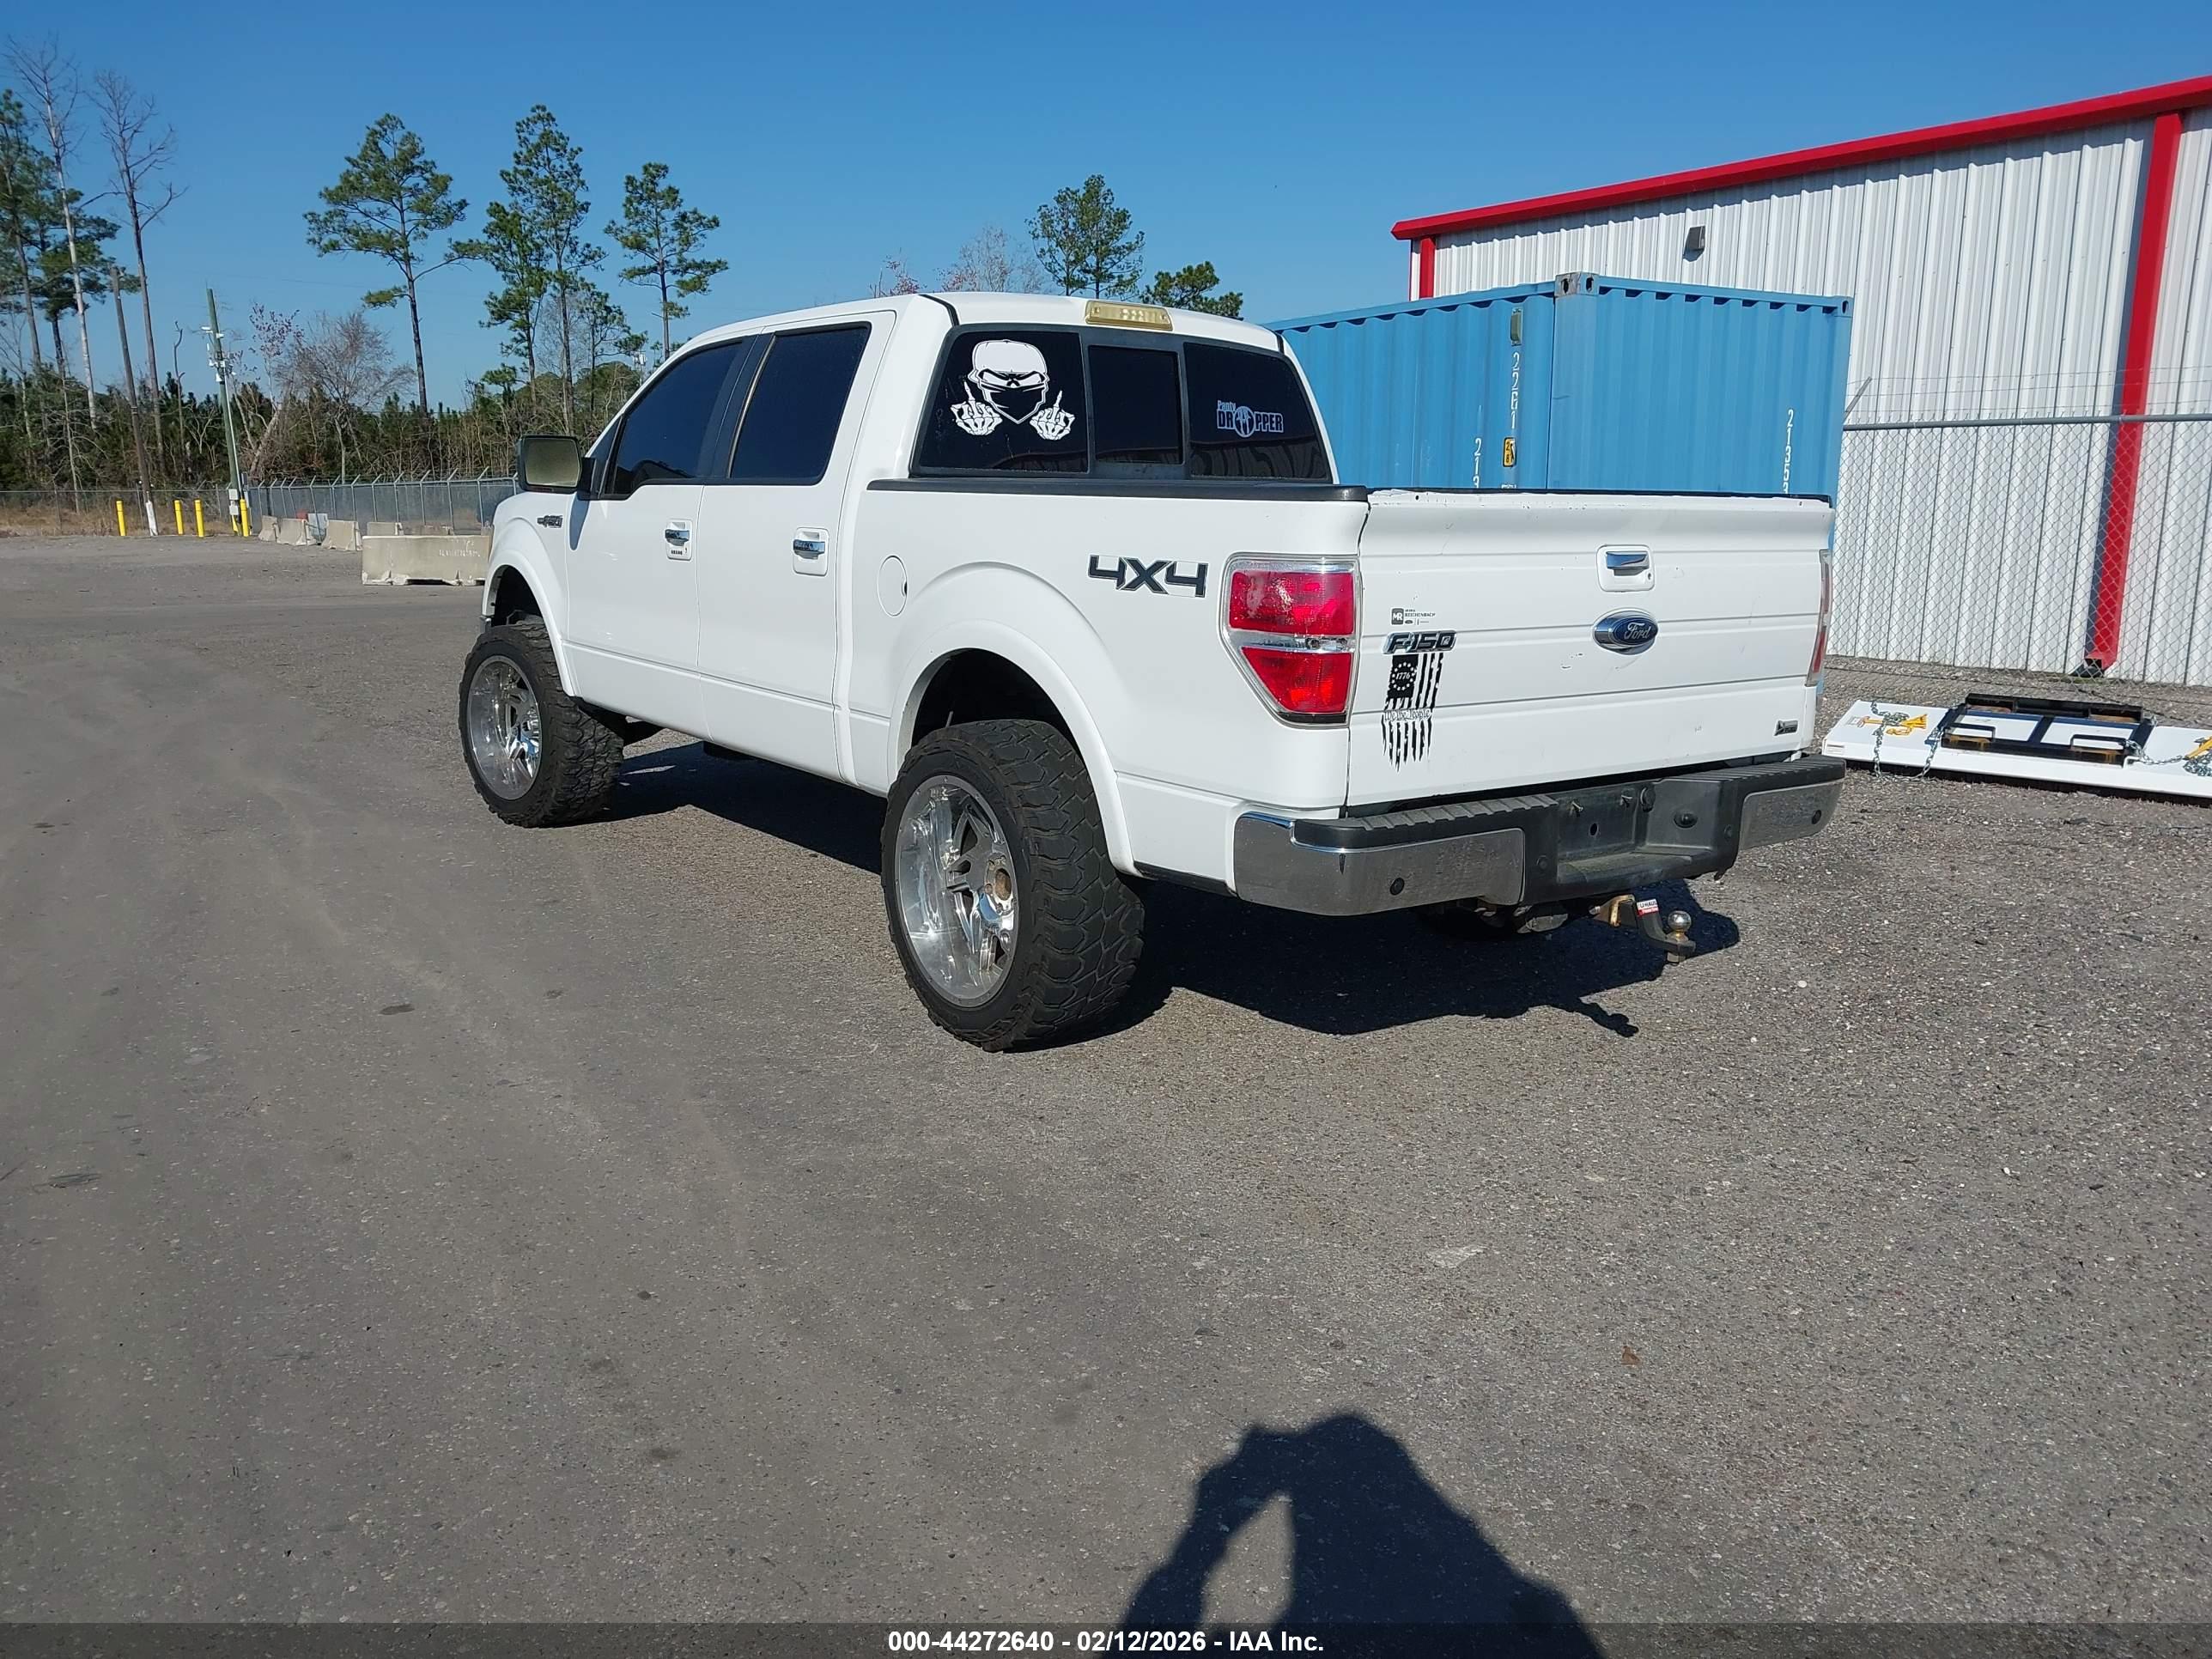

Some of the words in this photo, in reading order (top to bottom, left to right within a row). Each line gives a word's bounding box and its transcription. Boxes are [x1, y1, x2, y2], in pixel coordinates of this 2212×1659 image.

[1217, 399, 1237, 411] Panty
[1624, 622, 1651, 639] Ford
[1395, 672, 1411, 680] 1776
